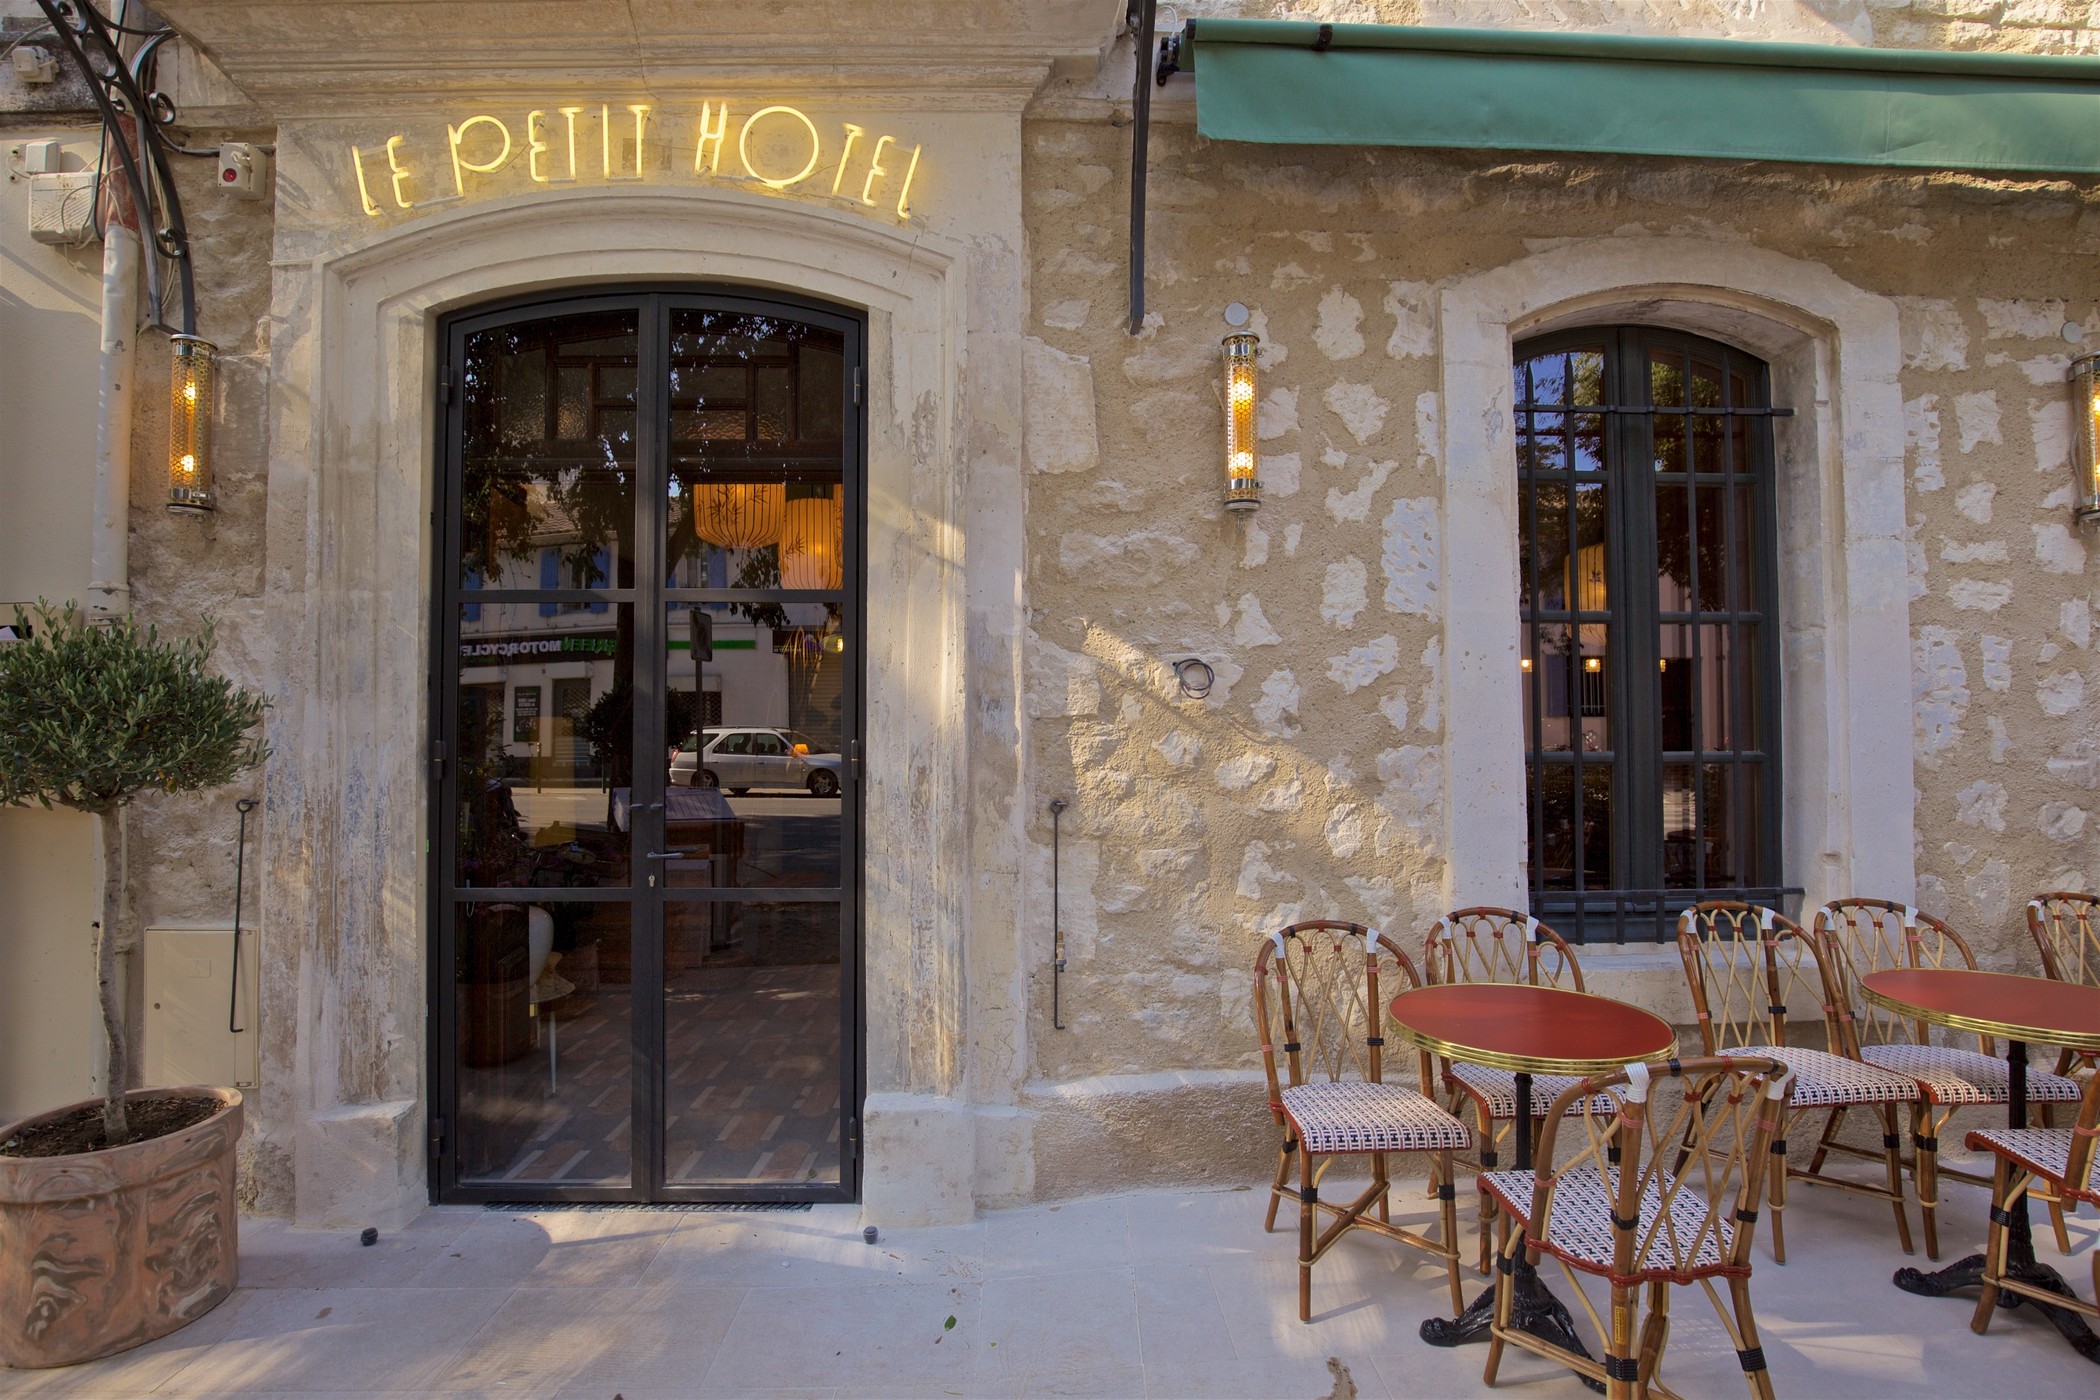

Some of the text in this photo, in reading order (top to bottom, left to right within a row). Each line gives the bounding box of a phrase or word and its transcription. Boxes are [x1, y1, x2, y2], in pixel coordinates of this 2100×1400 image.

[352, 100, 922, 219] LE PETIT HOTEL
